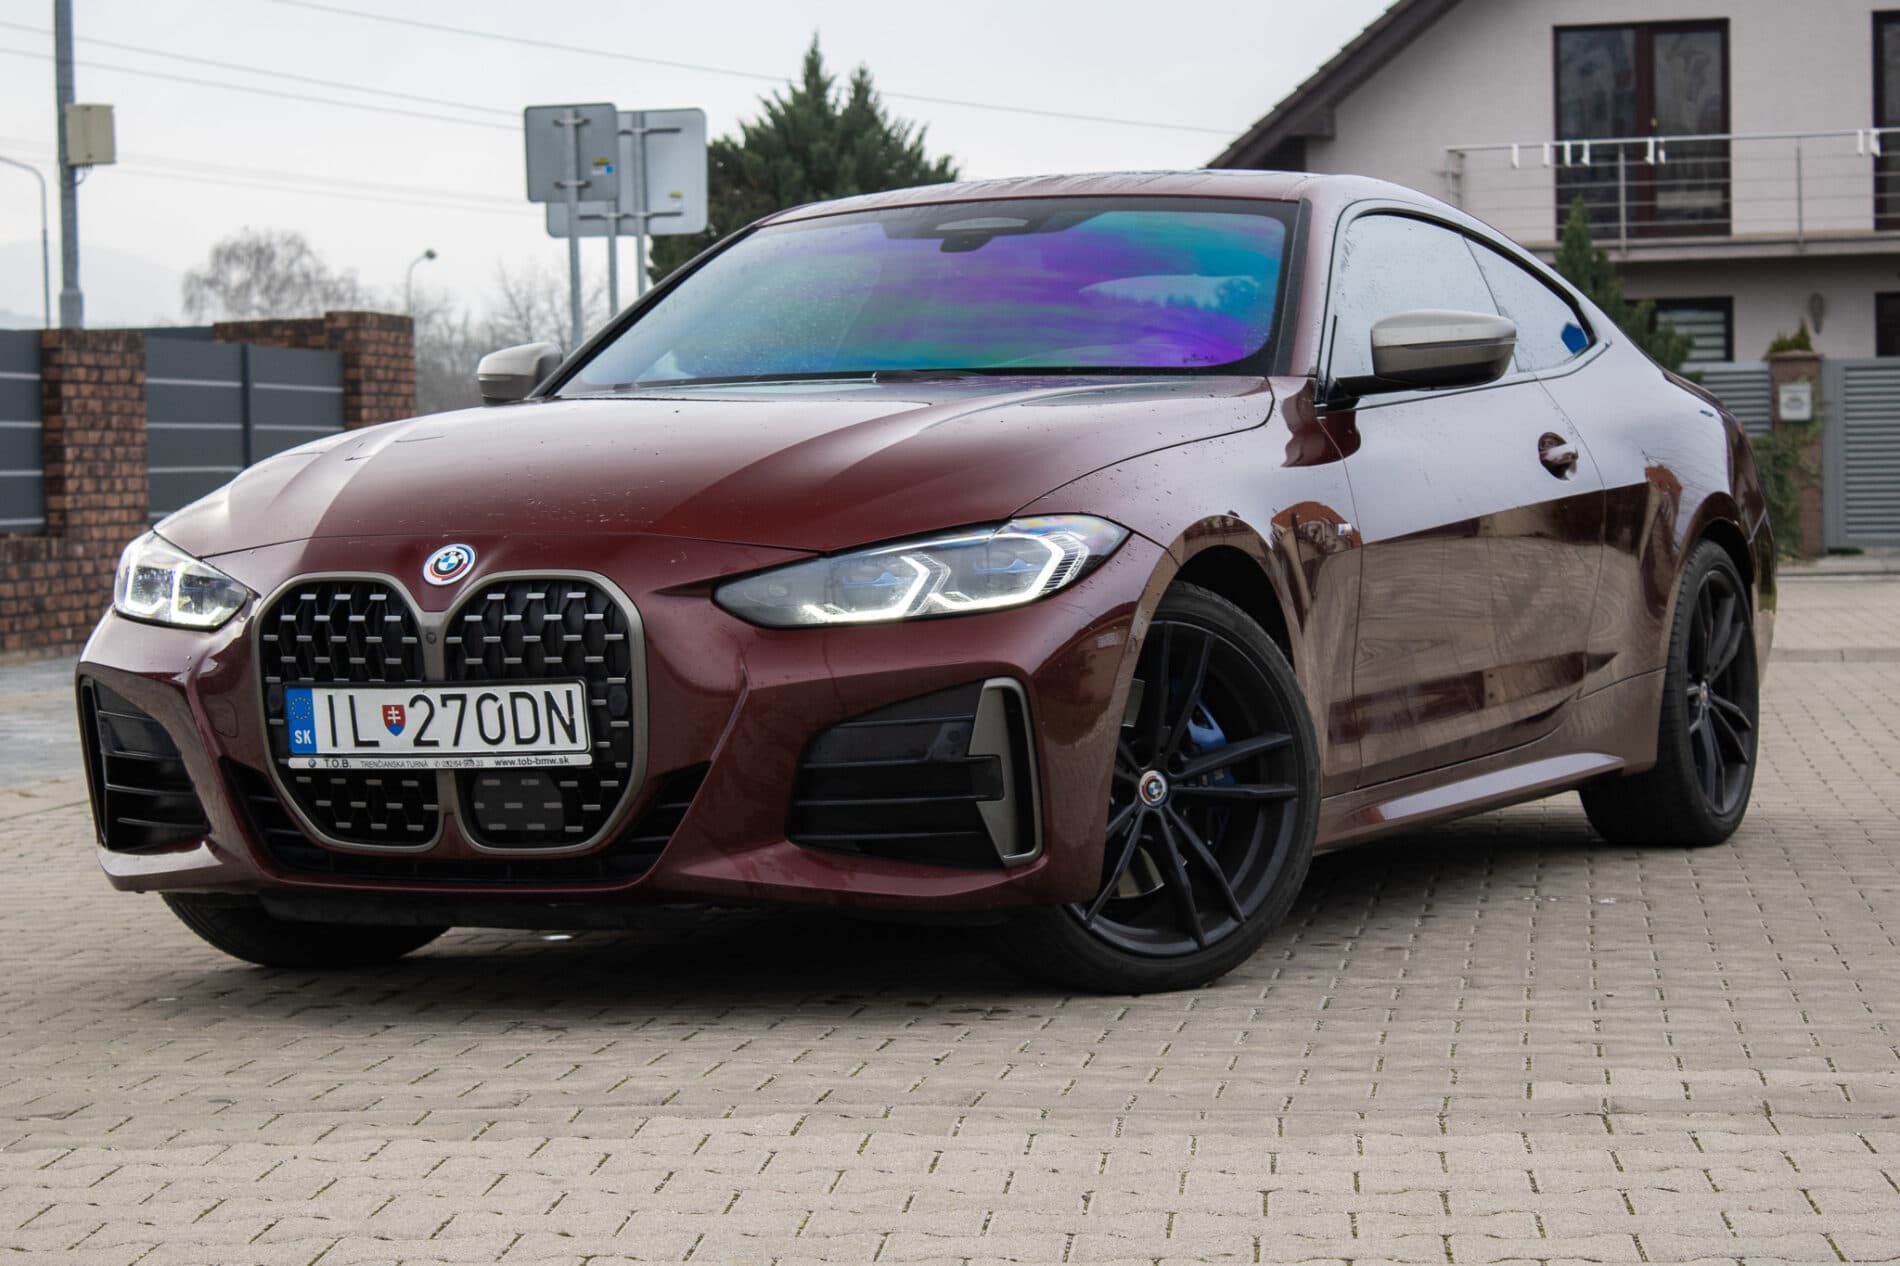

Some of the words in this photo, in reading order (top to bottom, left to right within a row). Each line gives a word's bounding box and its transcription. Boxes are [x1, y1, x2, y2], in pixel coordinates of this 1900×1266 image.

[327, 694, 379, 747] IL
[409, 689, 577, 747] 270DN
[294, 729, 312, 745] SK
[494, 755, 569, 766] www.tob-bmw.sk
